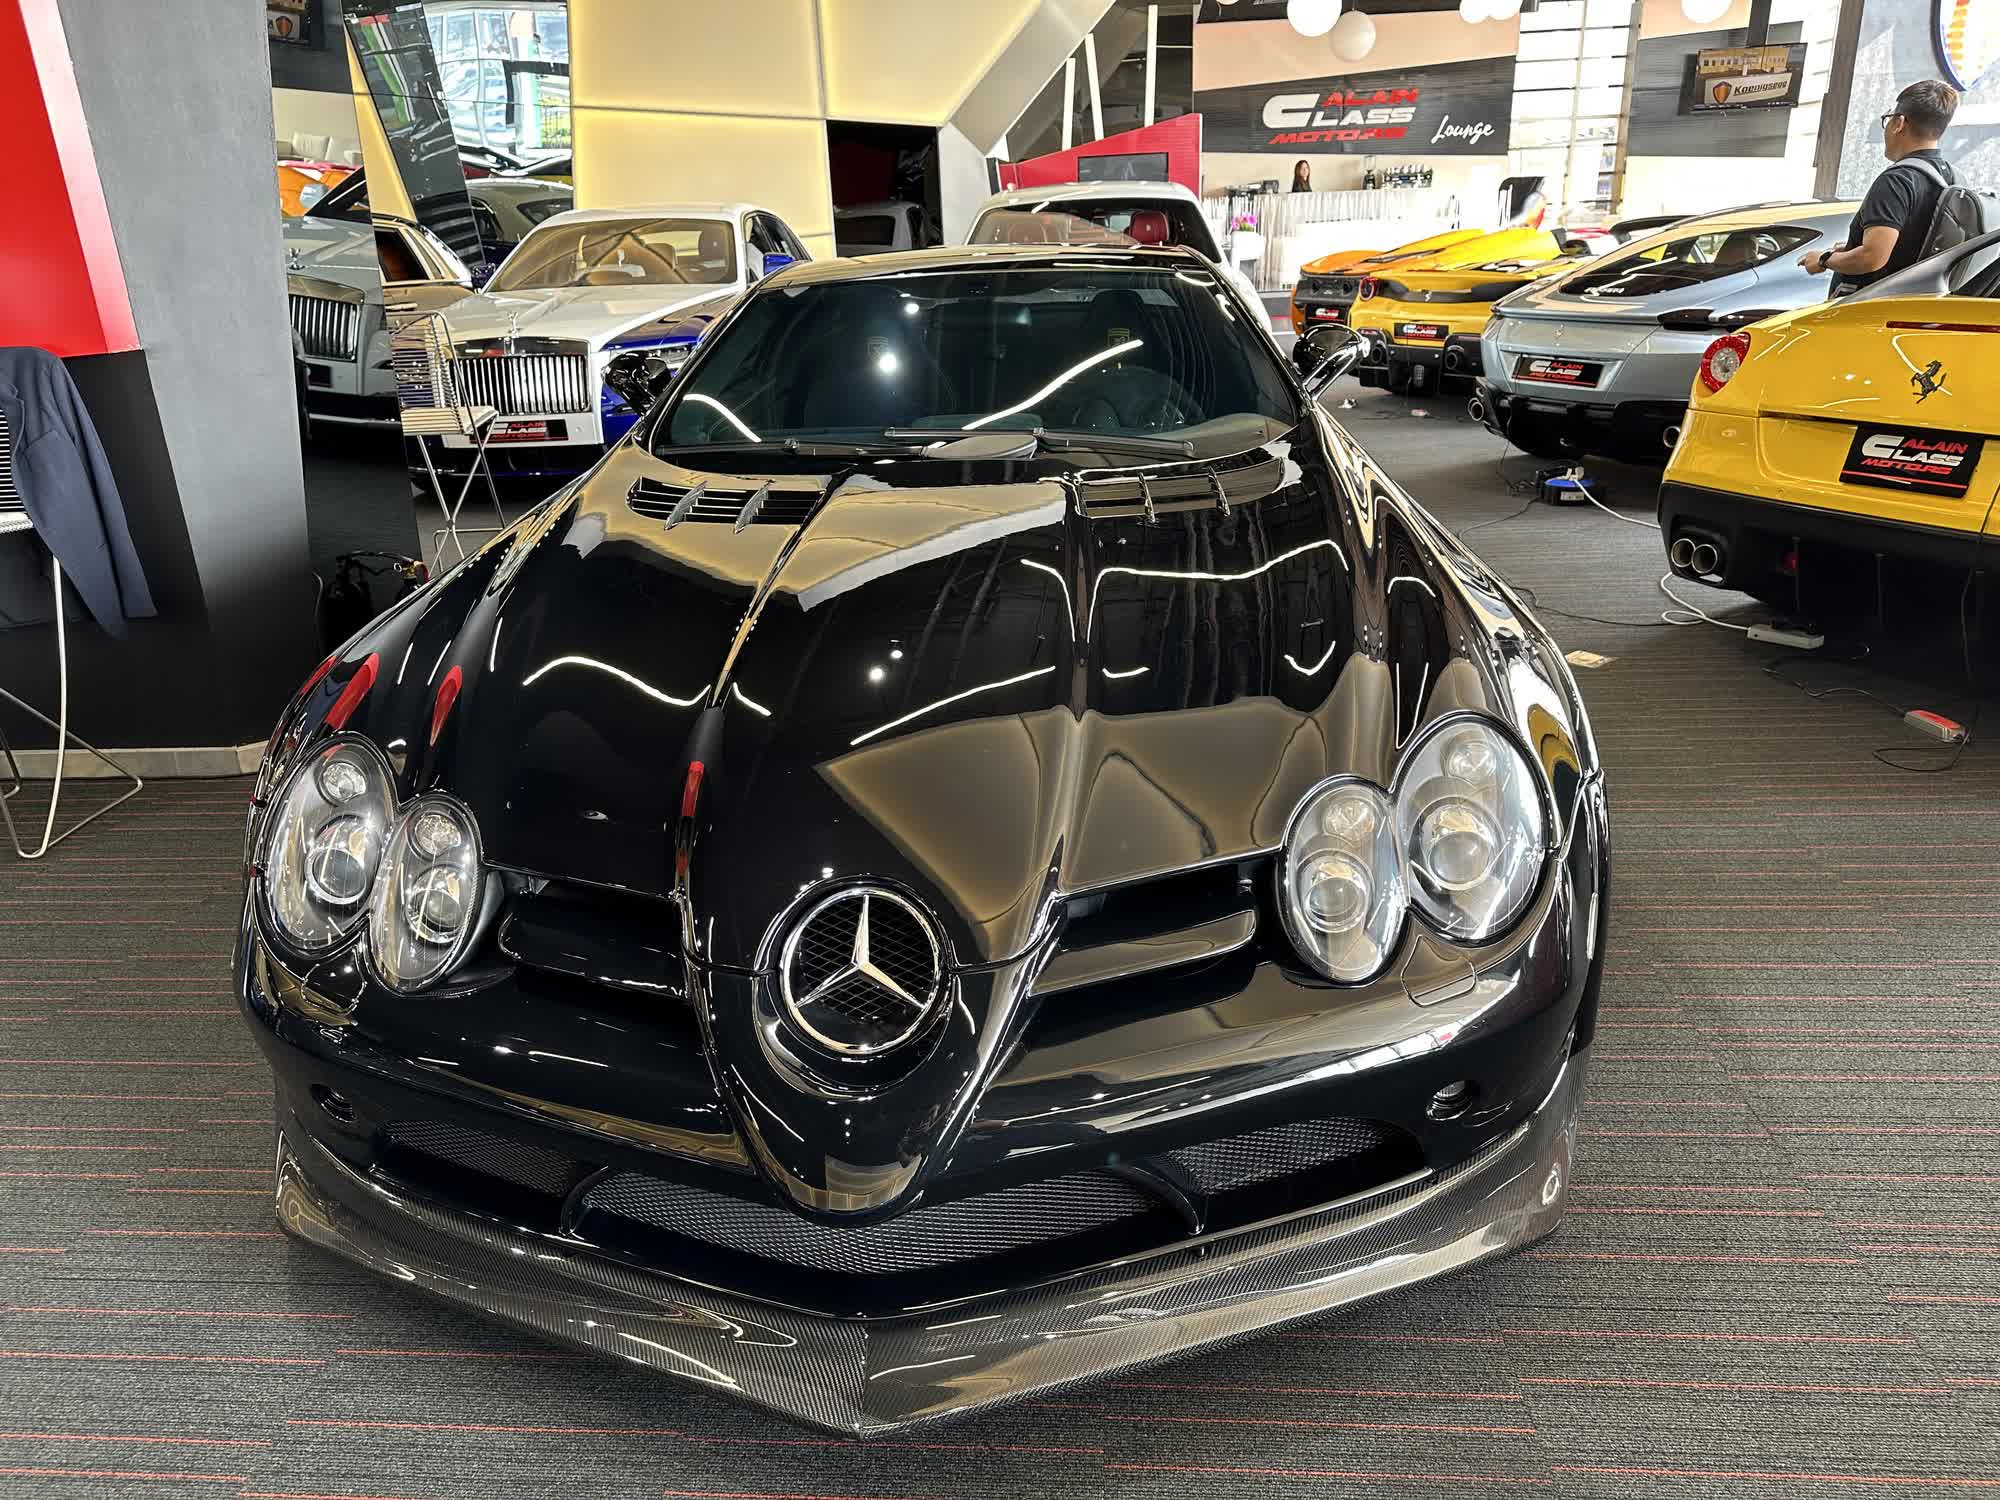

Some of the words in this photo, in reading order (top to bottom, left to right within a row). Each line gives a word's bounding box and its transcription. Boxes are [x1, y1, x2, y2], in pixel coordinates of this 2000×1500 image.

[1322, 88, 1419, 107] ALAIN
[1263, 93, 1416, 129] CLASS
[1268, 127, 1408, 145] MOTORS
[1431, 115, 1494, 145] Lounge
[1529, 360, 1582, 376] CLASS
[1551, 362, 1584, 370] ALAIN
[511, 420, 545, 428] ALAIN
[1861, 433, 1964, 467] CLASS
[1902, 438, 1969, 454] ALAIN
[1860, 458, 1953, 475] MOTORS
